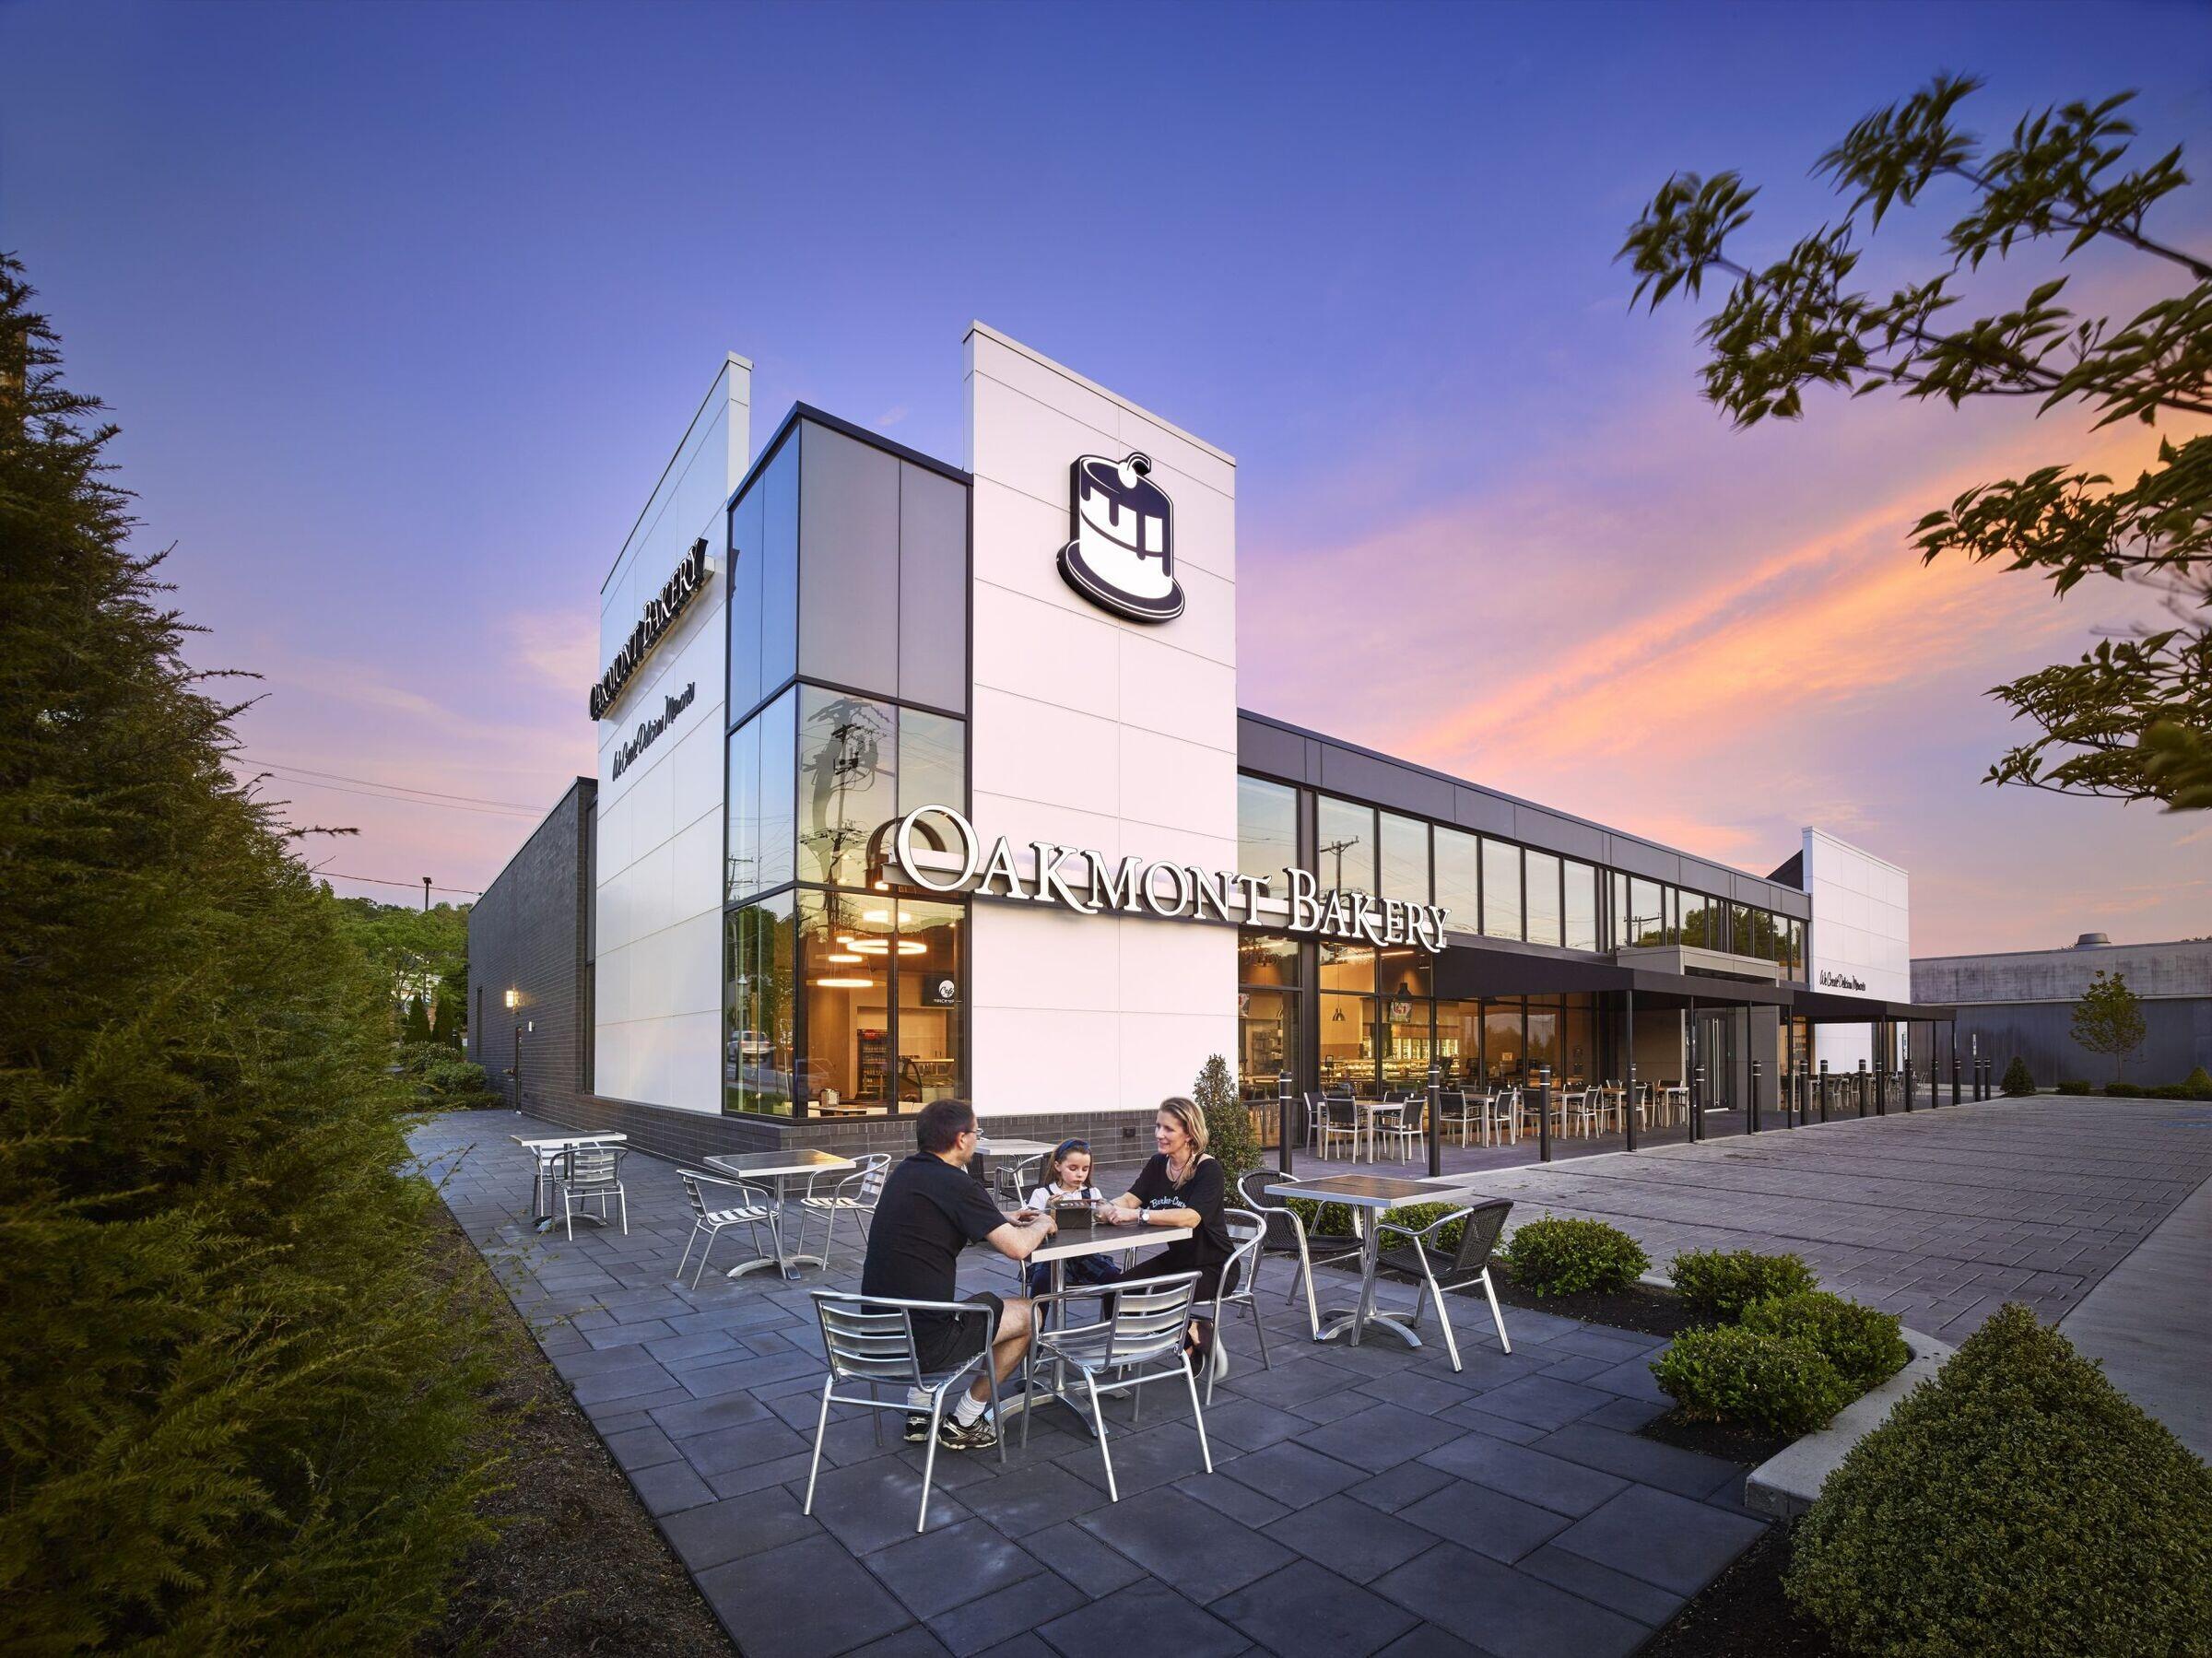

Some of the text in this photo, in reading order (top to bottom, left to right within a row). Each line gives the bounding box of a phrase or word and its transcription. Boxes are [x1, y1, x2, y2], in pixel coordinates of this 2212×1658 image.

[589, 537, 709, 722] OAKMONT BAKERY
[895, 804, 1453, 954] OAKMONT BAKERY
